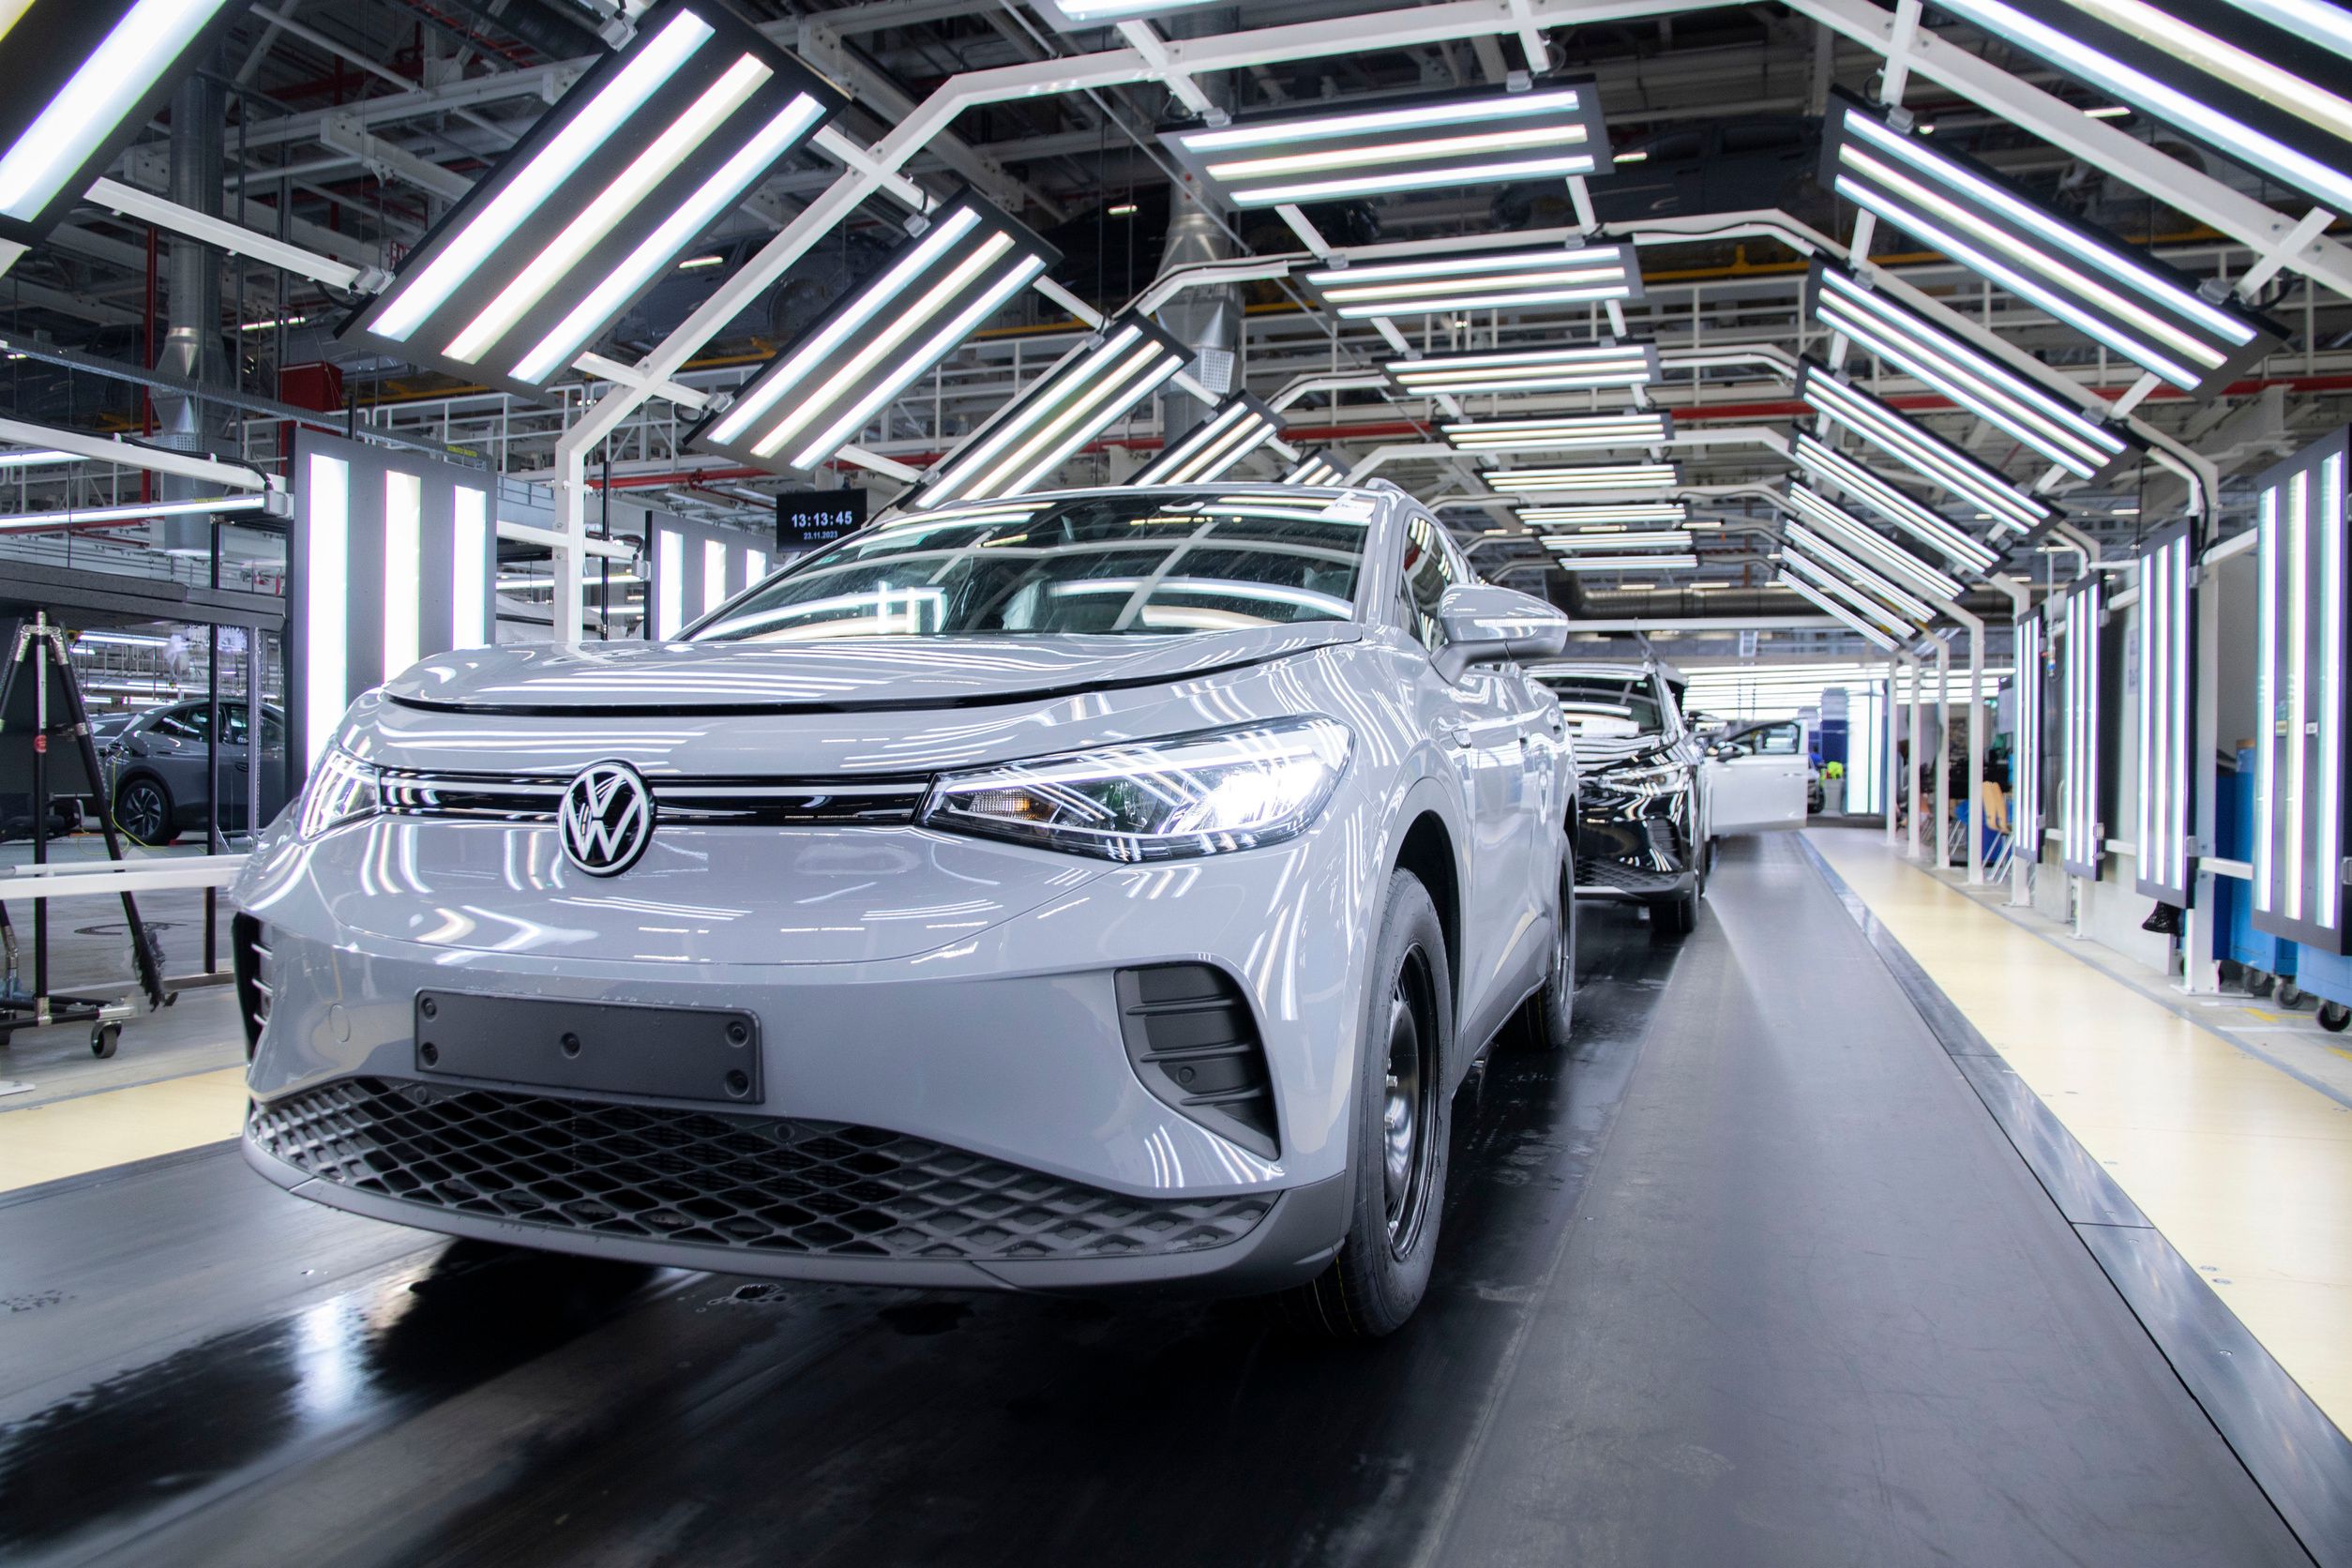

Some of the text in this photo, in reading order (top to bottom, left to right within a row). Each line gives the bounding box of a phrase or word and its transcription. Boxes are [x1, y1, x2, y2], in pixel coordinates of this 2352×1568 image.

[792, 511, 852, 528] 13:13:45
[803, 531, 838, 540] 23.11.2023
[563, 768, 645, 867] VW
